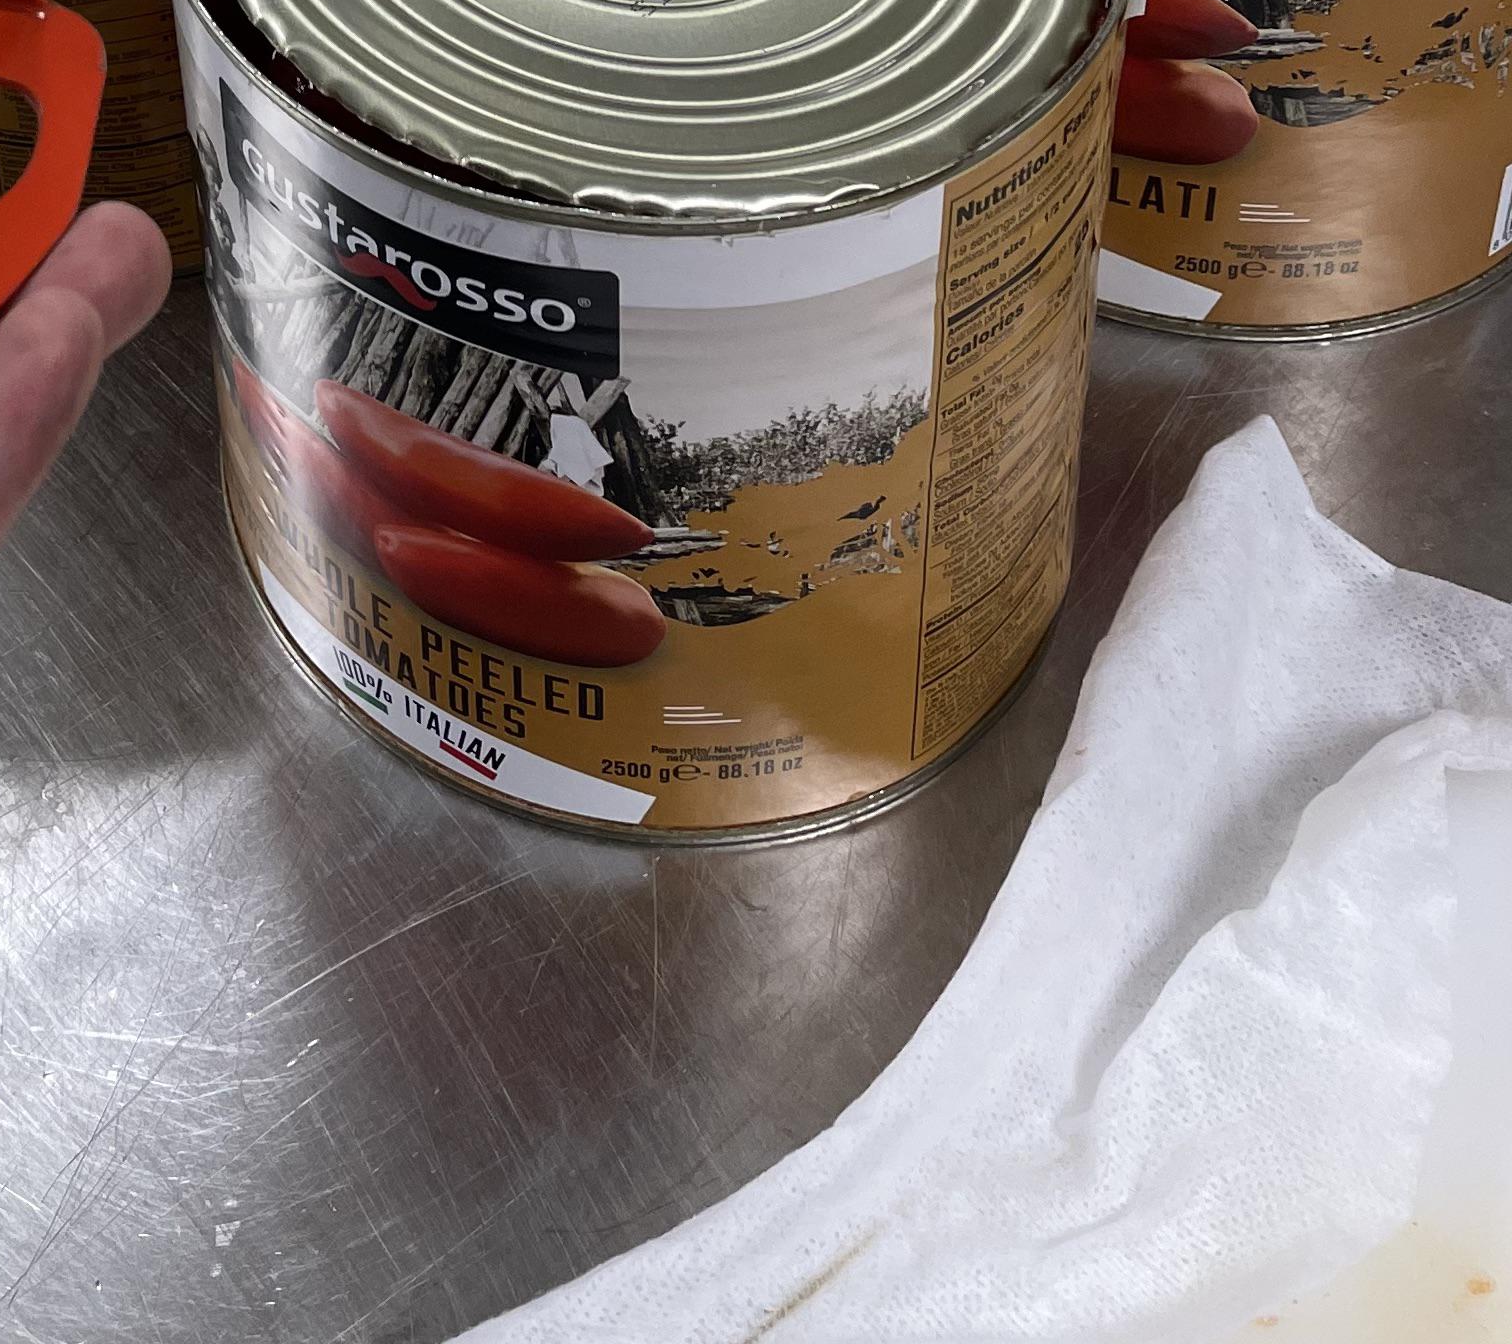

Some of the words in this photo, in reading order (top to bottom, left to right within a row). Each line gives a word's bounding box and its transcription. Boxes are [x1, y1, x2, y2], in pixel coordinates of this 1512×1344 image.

[956, 143, 1056, 227] Nutrition
[1109, 167, 1217, 222] LATI
[950, 257, 999, 291] Serving
[1004, 236, 1026, 257] size
[1174, 255, 1221, 275] 2500
[1282, 260, 1335, 279] 88.18
[1340, 259, 1360, 274] oz
[946, 303, 1025, 365] Calories
[940, 399, 967, 419] Total
[969, 385, 986, 401] Fat
[323, 591, 526, 739] TOMATOES
[421, 624, 604, 721] PEELED
[333, 645, 393, 704] 100%
[405, 695, 506, 771] ITALIAN
[601, 759, 651, 779] 2500
[718, 759, 774, 780] 88.18
[782, 757, 803, 772] oz
